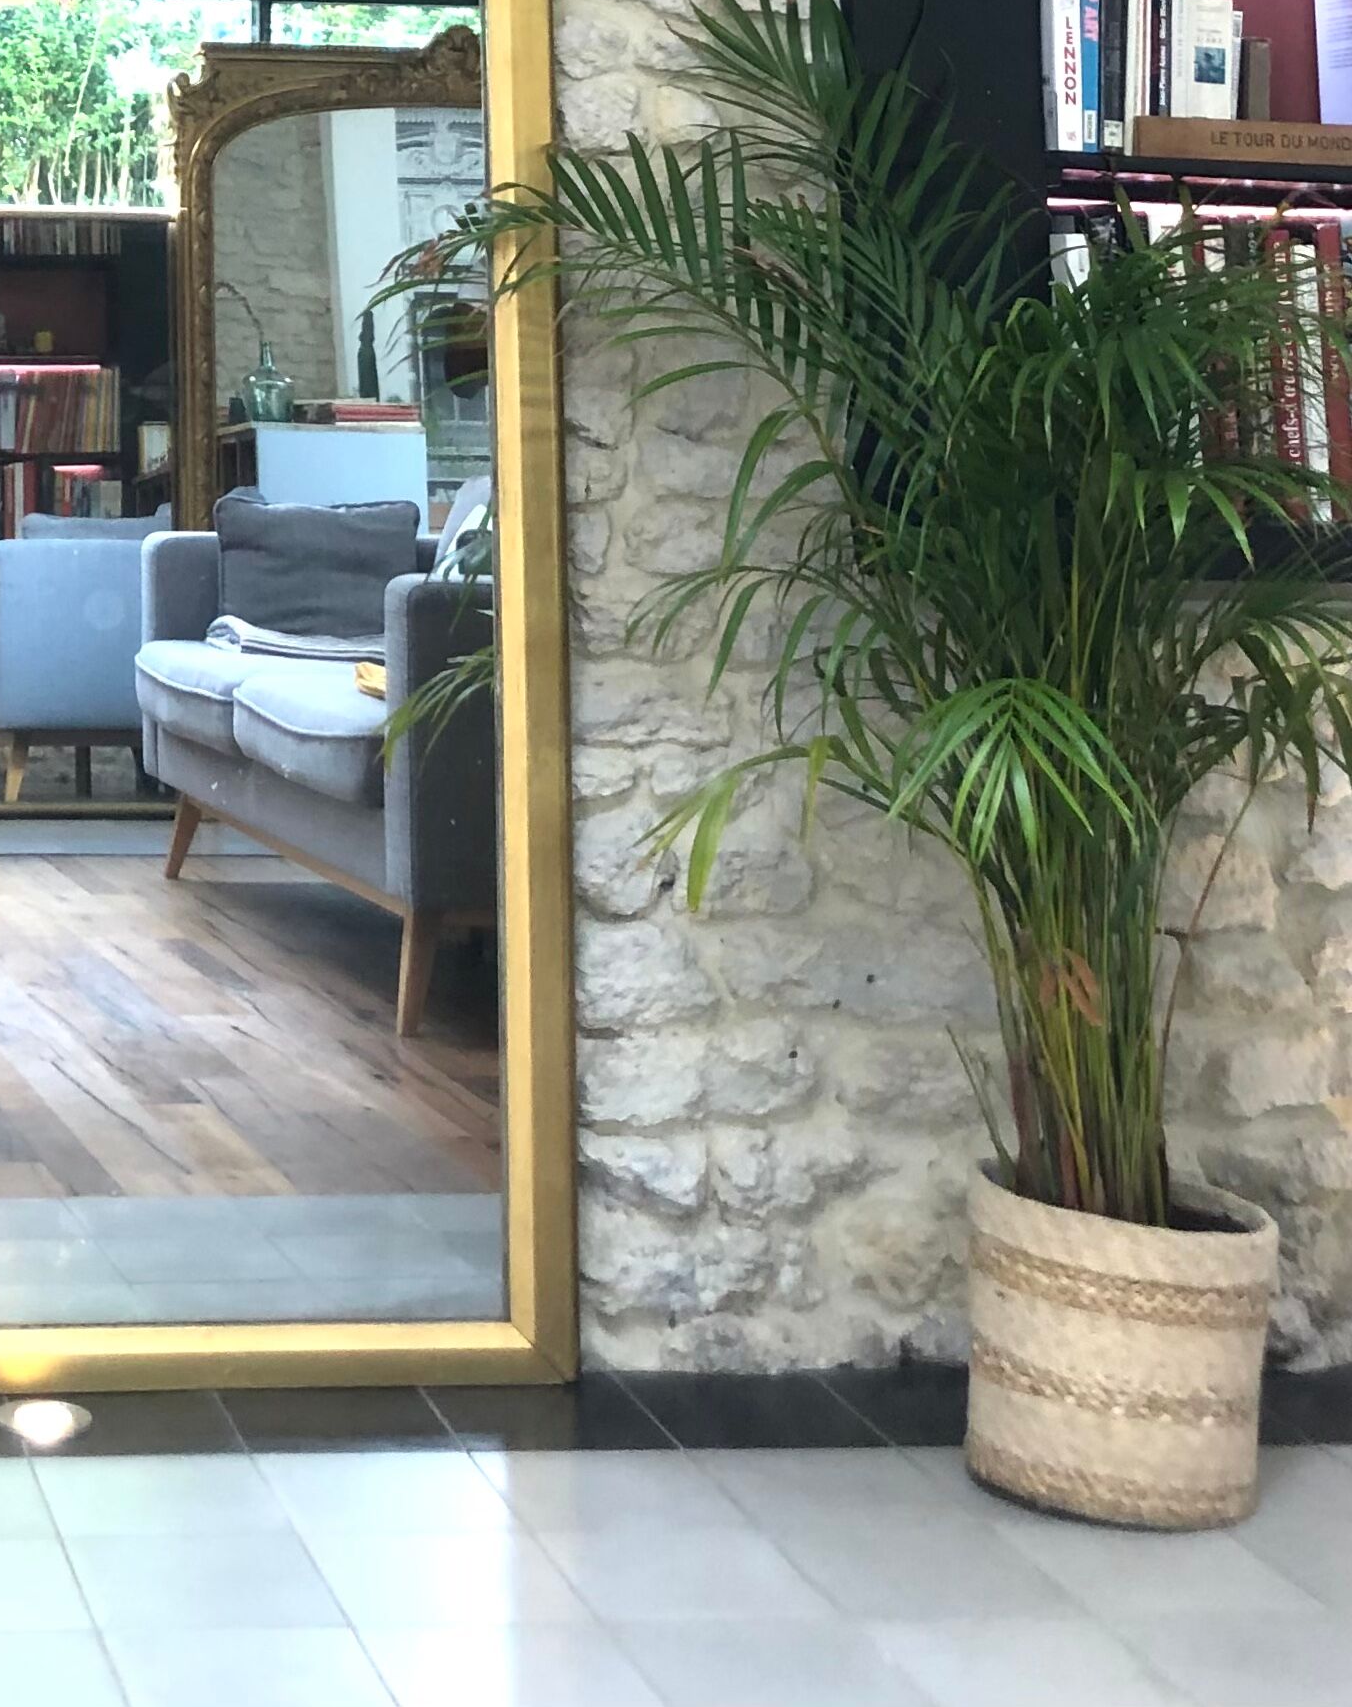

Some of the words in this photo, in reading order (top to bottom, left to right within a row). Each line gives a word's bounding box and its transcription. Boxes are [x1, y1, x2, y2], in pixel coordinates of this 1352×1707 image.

[1083, 6, 1098, 42] ART
[1063, 17, 1077, 105] LENNON
[1210, 131, 1228, 146] LE
[1232, 132, 1276, 148] TOUR
[1280, 135, 1303, 149] DU
